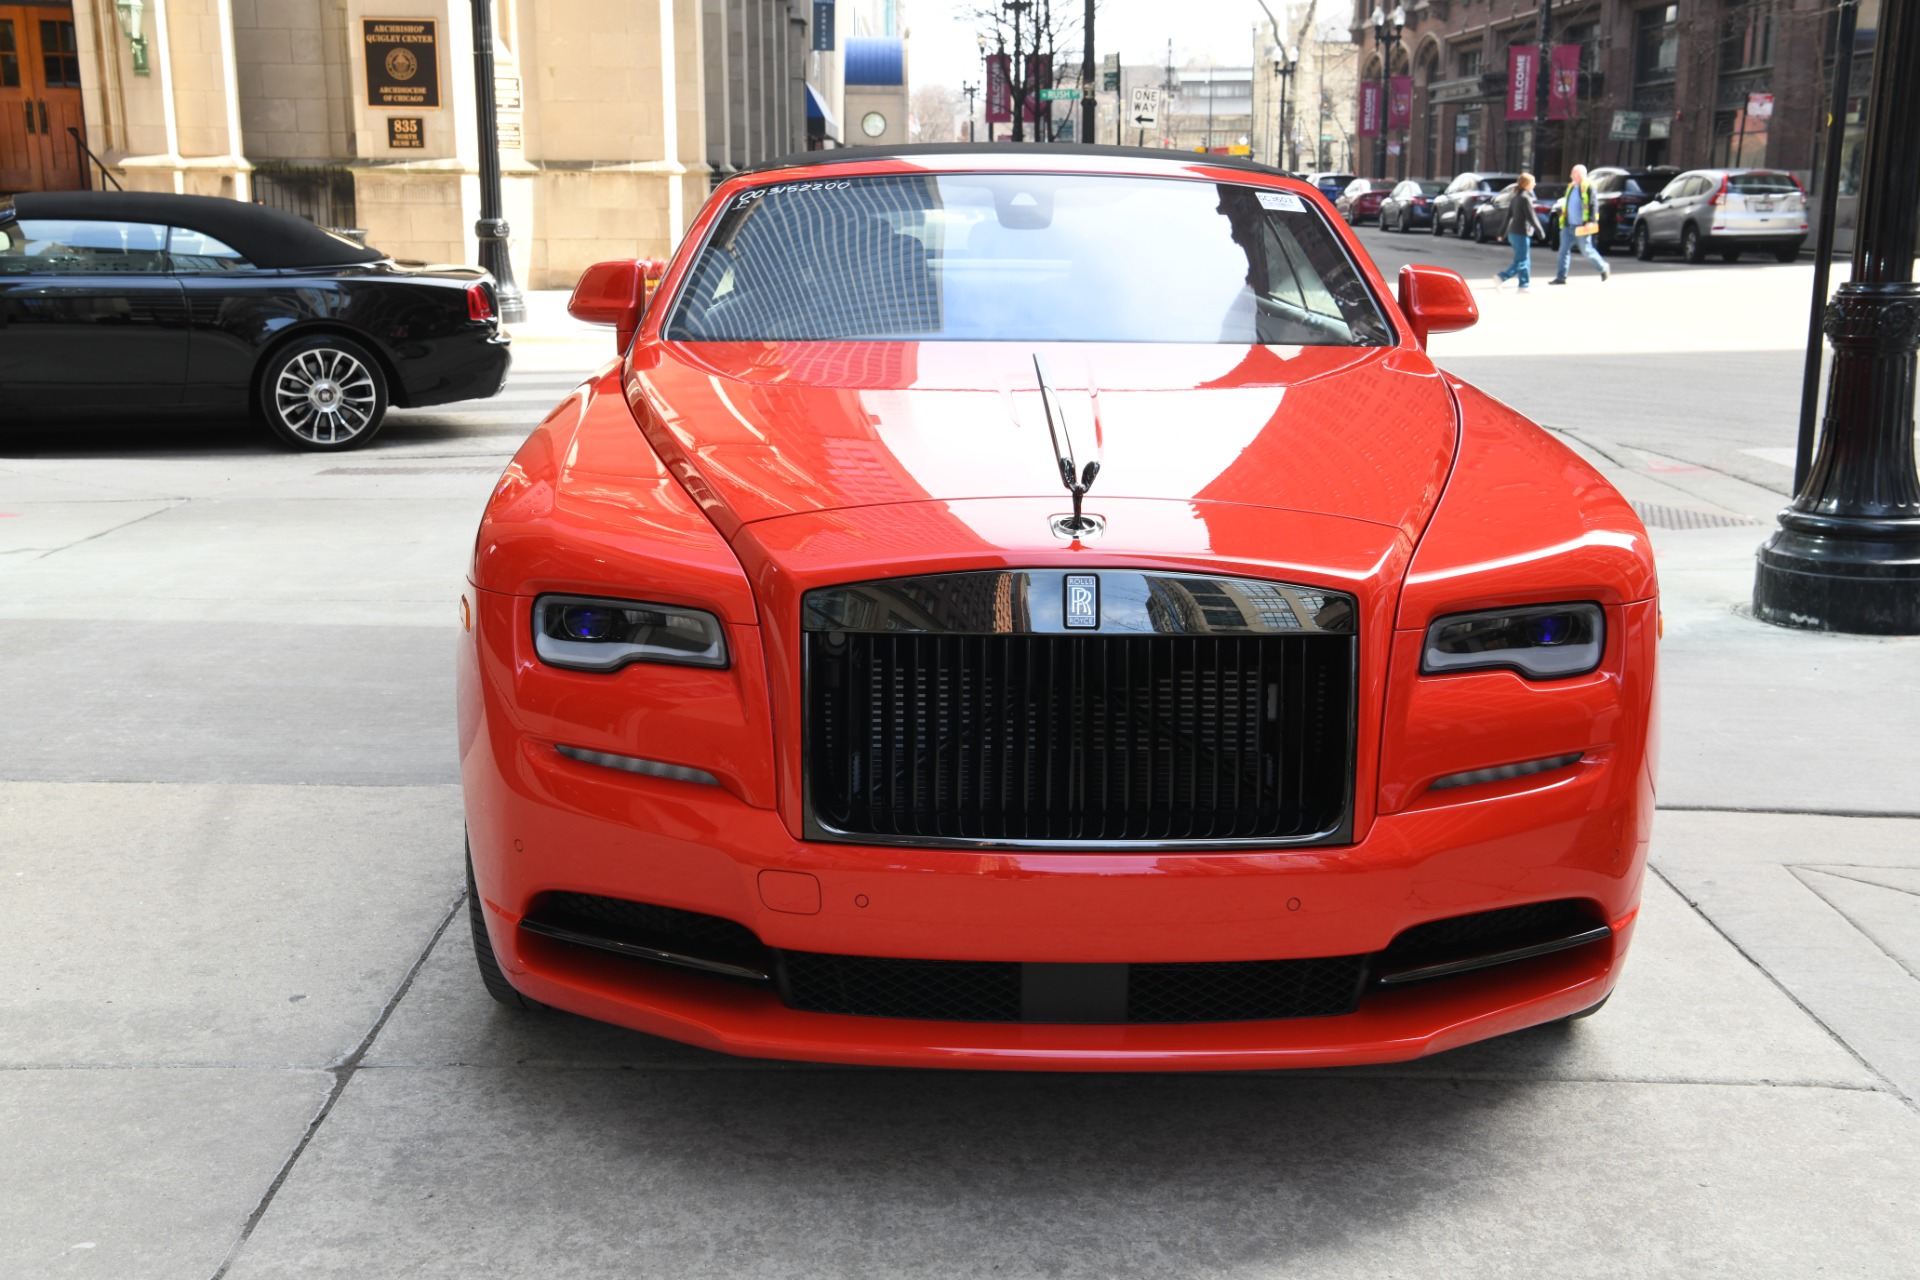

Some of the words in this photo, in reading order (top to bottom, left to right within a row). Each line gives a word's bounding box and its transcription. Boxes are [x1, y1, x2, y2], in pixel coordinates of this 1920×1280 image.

[374, 25, 425, 33] ARCHBISHOP
[366, 34, 401, 43] QUIGLEY
[401, 35, 434, 43] CENTER
[1513, 55, 1525, 111] WELCOME
[379, 86, 427, 94] ARCHDIOCESE
[1047, 90, 1070, 99] RUSH
[1135, 90, 1158, 102] ONE
[1133, 102, 1157, 112] WAY
[1363, 88, 1372, 130] WELCOME
[394, 119, 418, 133] 835
[1071, 587, 1092, 615] RR
